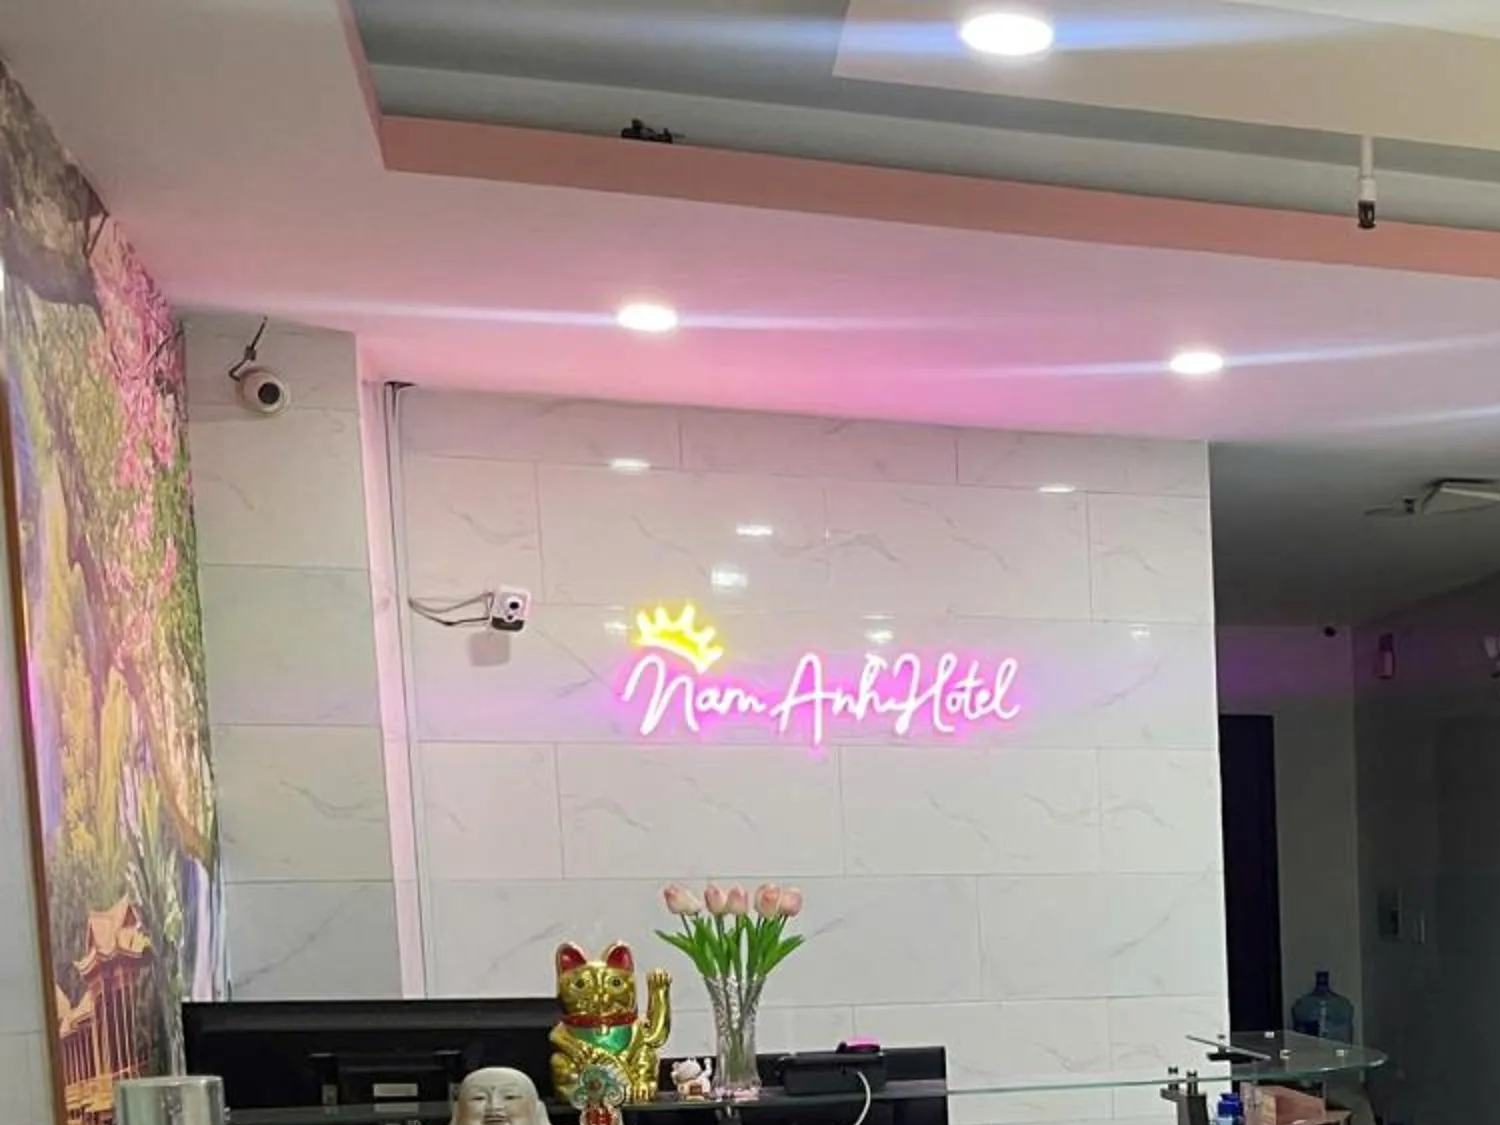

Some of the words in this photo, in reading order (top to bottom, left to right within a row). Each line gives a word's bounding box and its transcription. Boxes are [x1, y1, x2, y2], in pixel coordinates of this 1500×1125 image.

[621, 653, 765, 735] Nam
[769, 652, 890, 746] Anh
[889, 651, 1021, 734] Hotel
